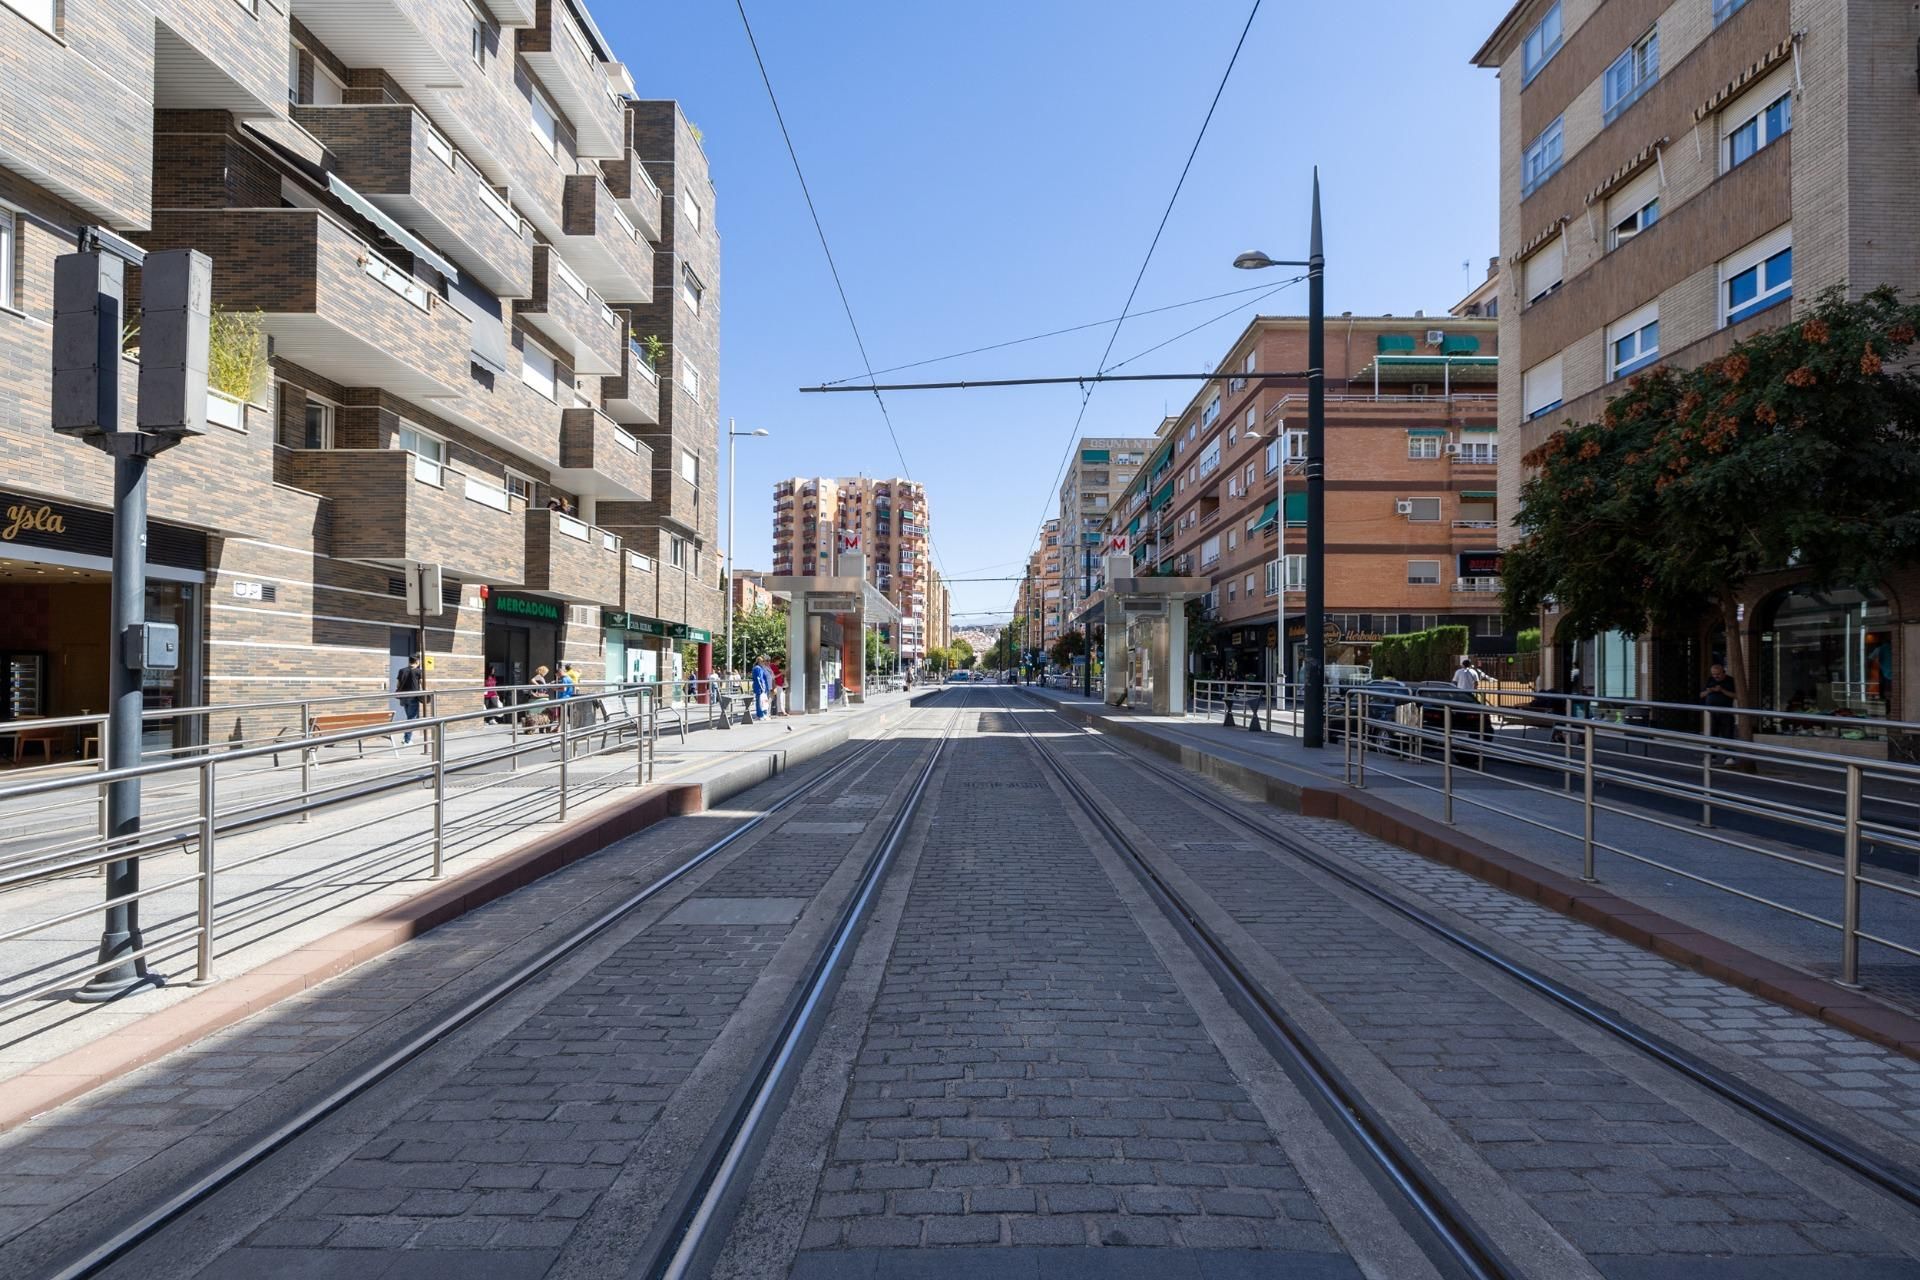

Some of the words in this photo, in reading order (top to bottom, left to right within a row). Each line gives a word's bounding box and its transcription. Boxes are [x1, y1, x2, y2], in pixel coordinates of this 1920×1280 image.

[845, 535, 858, 549] M
[1113, 538, 1126, 551] M
[497, 596, 558, 619] MERCADONA
